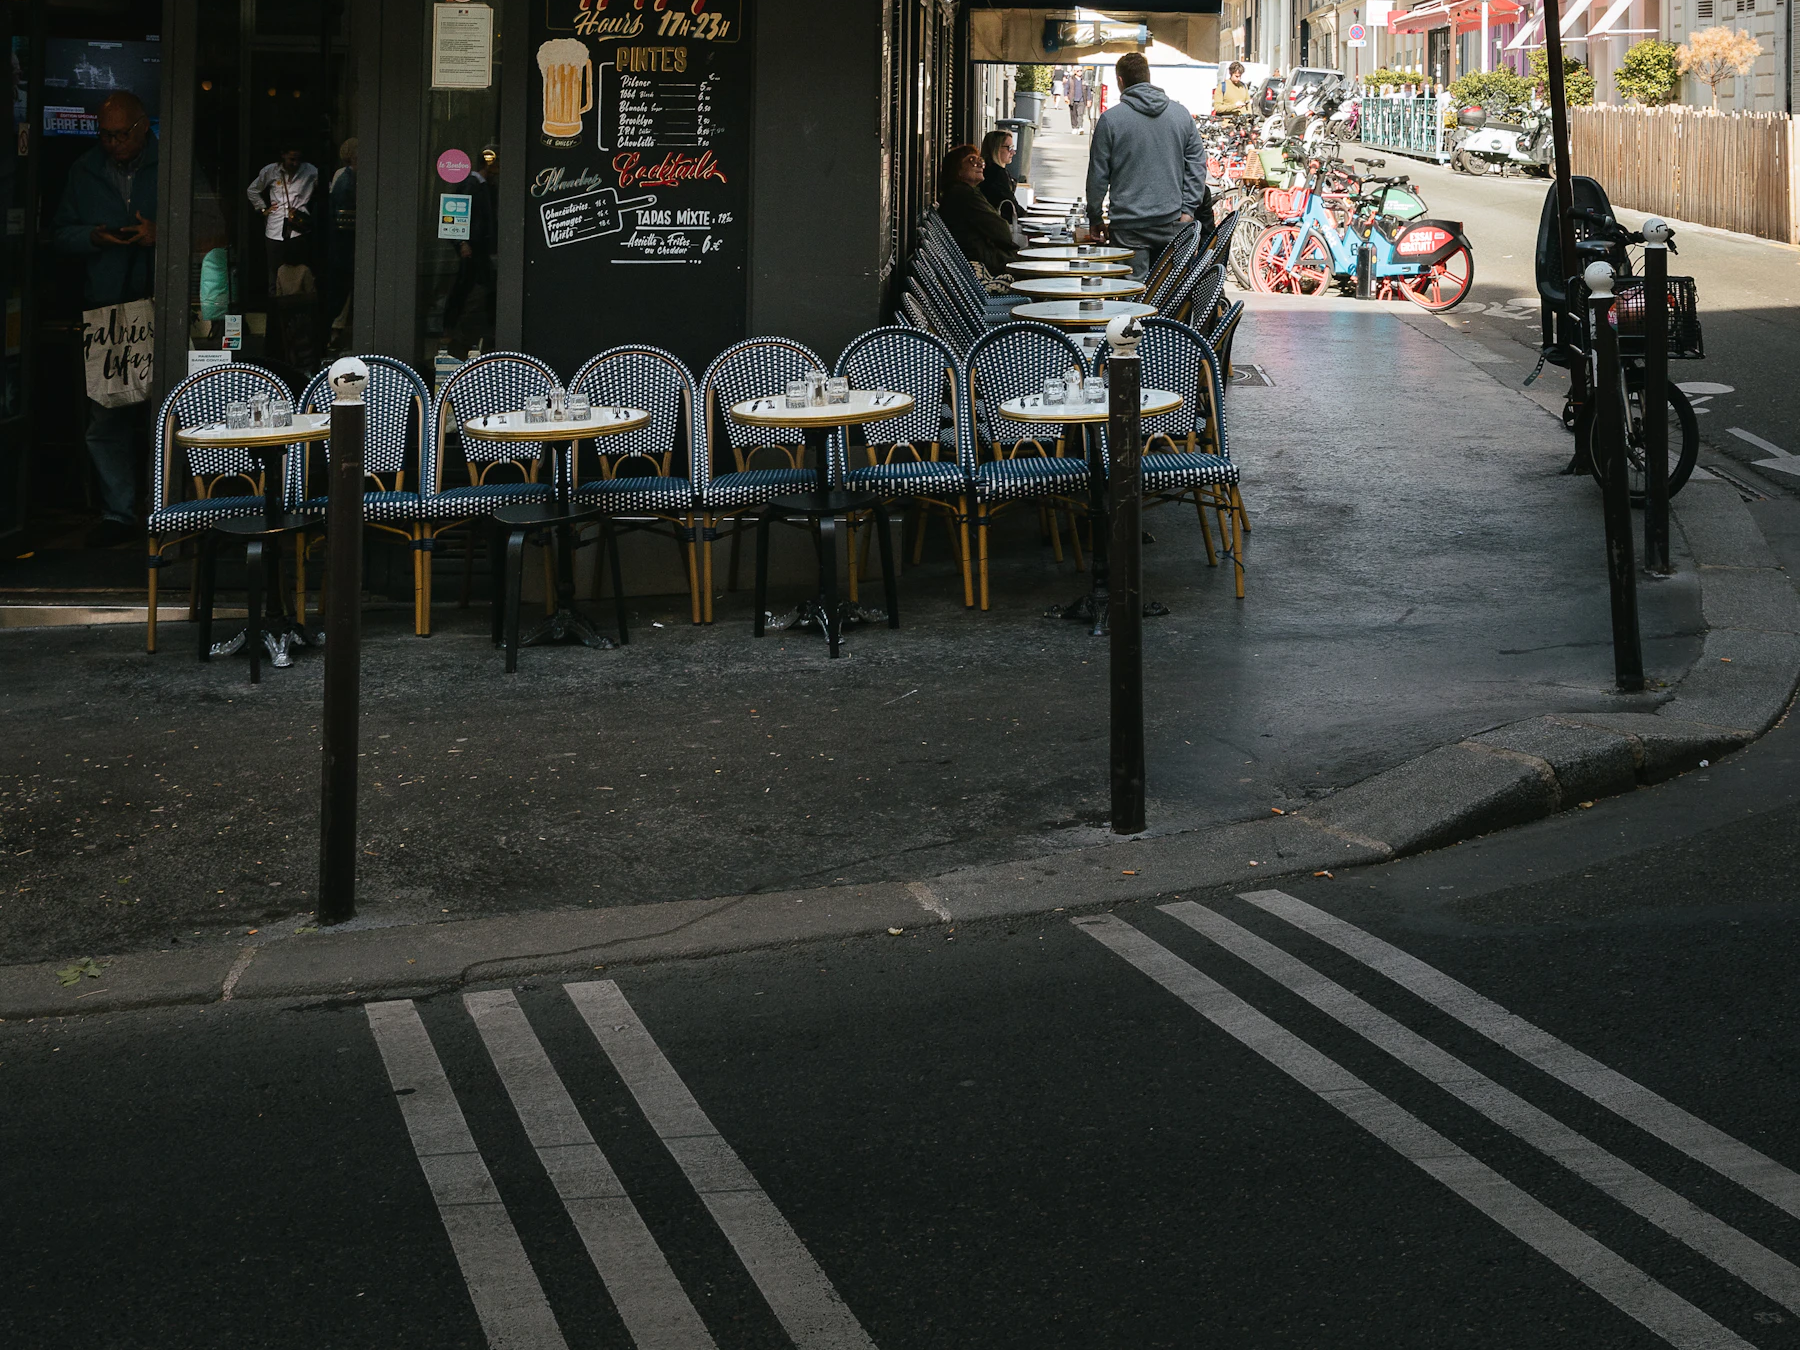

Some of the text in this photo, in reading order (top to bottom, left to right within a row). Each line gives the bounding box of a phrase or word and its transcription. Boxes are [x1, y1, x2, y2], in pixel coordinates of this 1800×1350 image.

[573, 11, 644, 42] Hours
[615, 46, 689, 72] PINTES
[620, 75, 652, 88] Pilsner
[620, 88, 637, 99] 1664
[618, 100, 648, 113] Blanche
[618, 113, 654, 127] Brooklyn
[446, 161, 469, 169] Bonbon
[612, 149, 728, 189] Cocktails
[547, 215, 583, 232] Fromages
[636, 210, 672, 226] TAPAS
[550, 227, 577, 243] Mixte
[622, 231, 657, 248] Assiette
[667, 231, 691, 247] Frites
[1409, 231, 1433, 242] ESSAI
